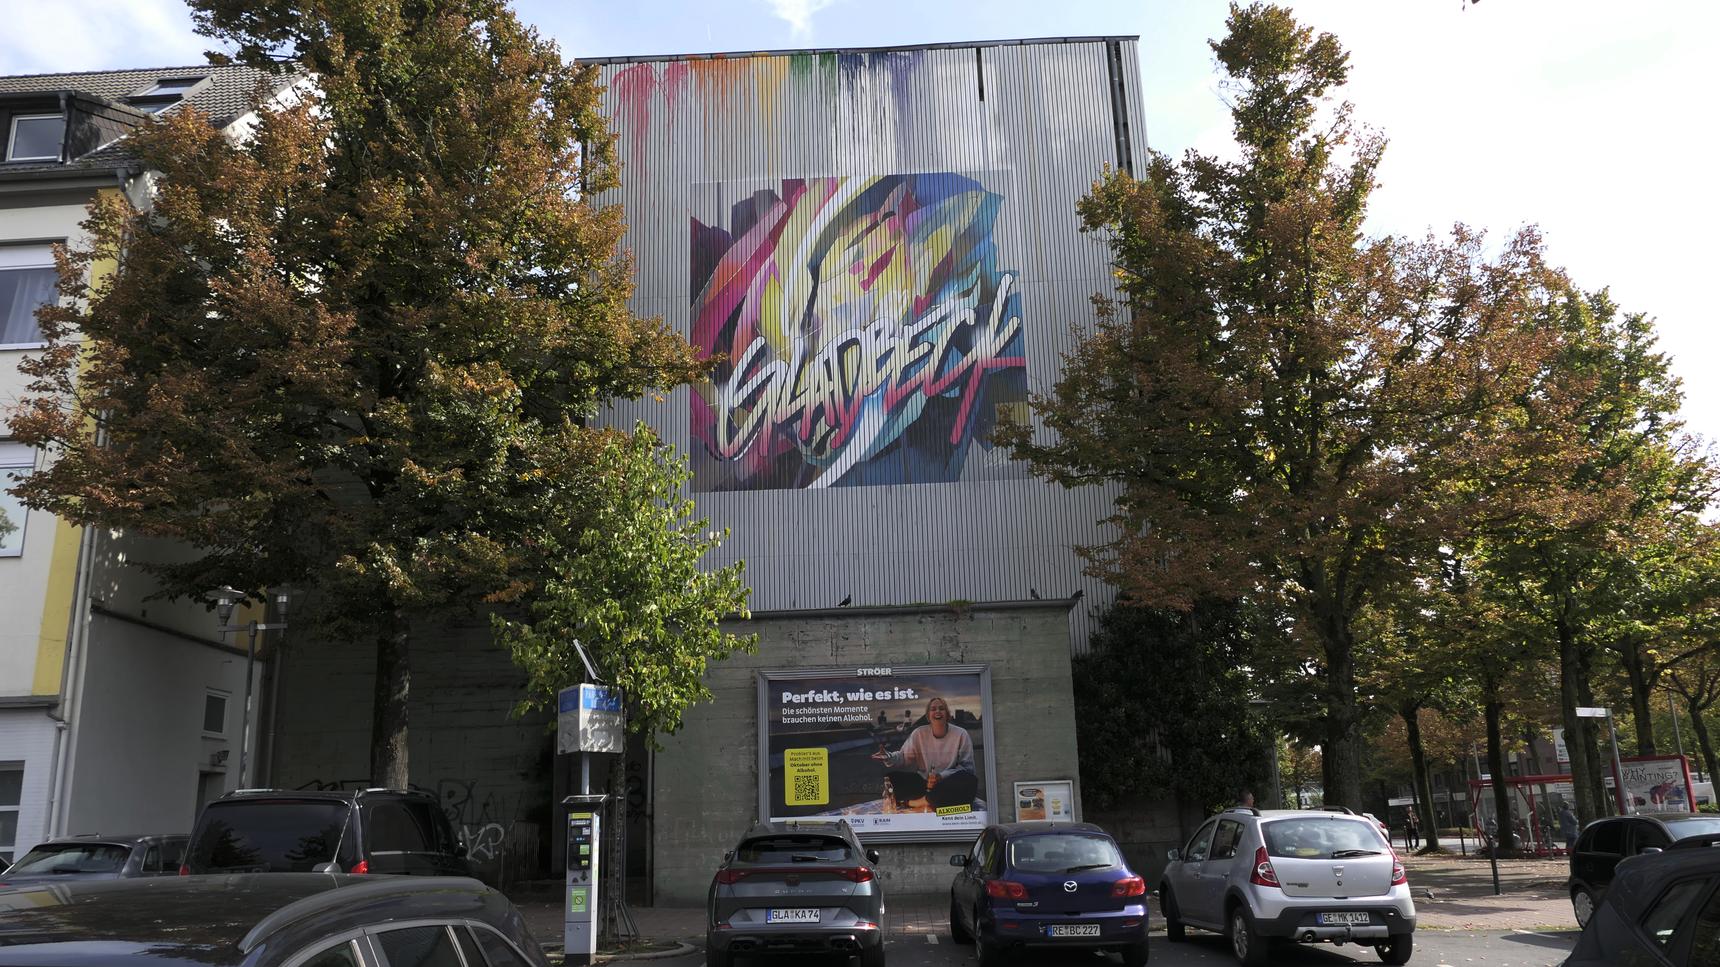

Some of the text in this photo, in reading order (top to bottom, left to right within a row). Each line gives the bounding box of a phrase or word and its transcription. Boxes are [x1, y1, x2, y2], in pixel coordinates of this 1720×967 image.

[857, 667, 892, 676] STRÖER
[782, 687, 919, 704] Perfekt, wie es ist.
[795, 706, 833, 714] schönsten
[833, 705, 868, 713] Momente
[782, 713, 873, 724] brauchen keinen Alkohol.
[1622, 768, 1646, 777] WHY
[1623, 772, 1678, 782] PAINTING?
[938, 805, 970, 815] ALKOHOL?
[772, 909, 819, 920] GLA KA 74
[1323, 912, 1369, 923] GE MK 1412
[1052, 925, 1099, 935] RE BC 227
